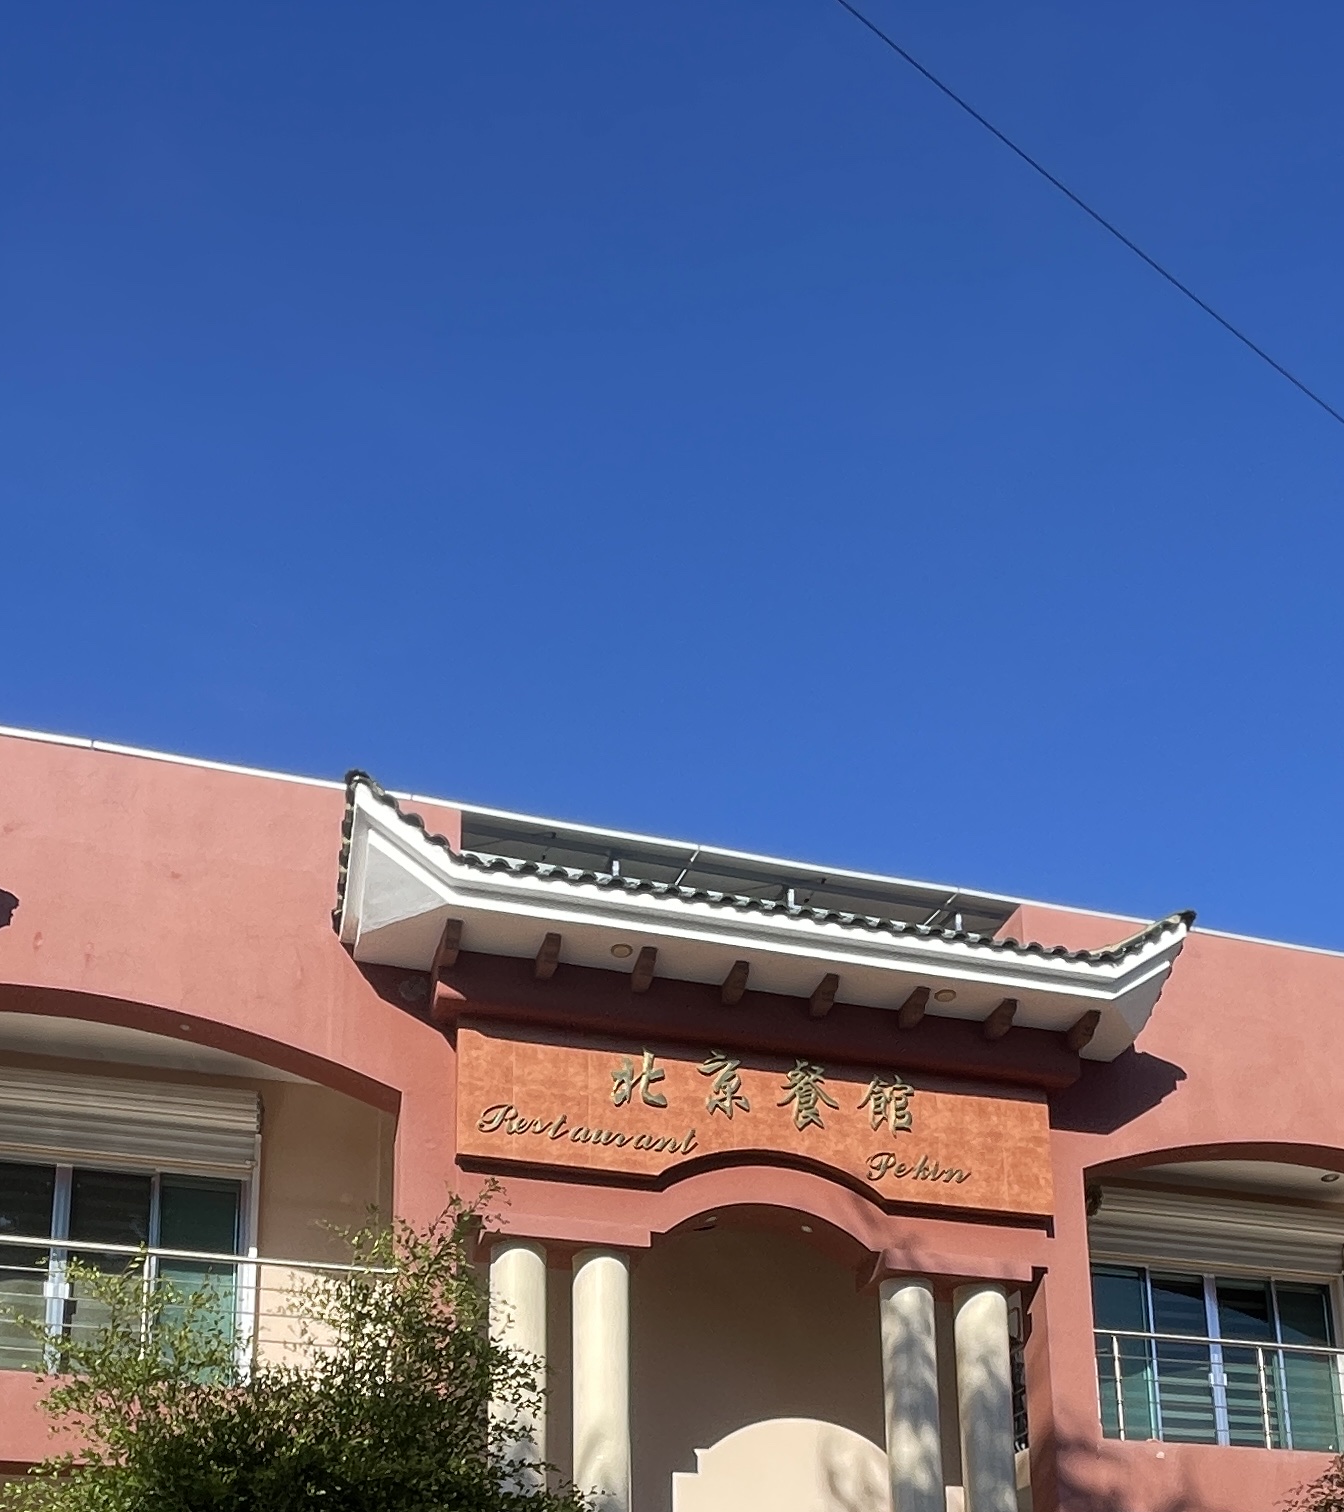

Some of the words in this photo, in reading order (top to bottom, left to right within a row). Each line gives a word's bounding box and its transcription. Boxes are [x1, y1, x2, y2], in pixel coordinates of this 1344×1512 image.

[610, 1047, 914, 1138] 北京餐館
[477, 1103, 699, 1155] Restaurant
[865, 1152, 972, 1184] Pekin
